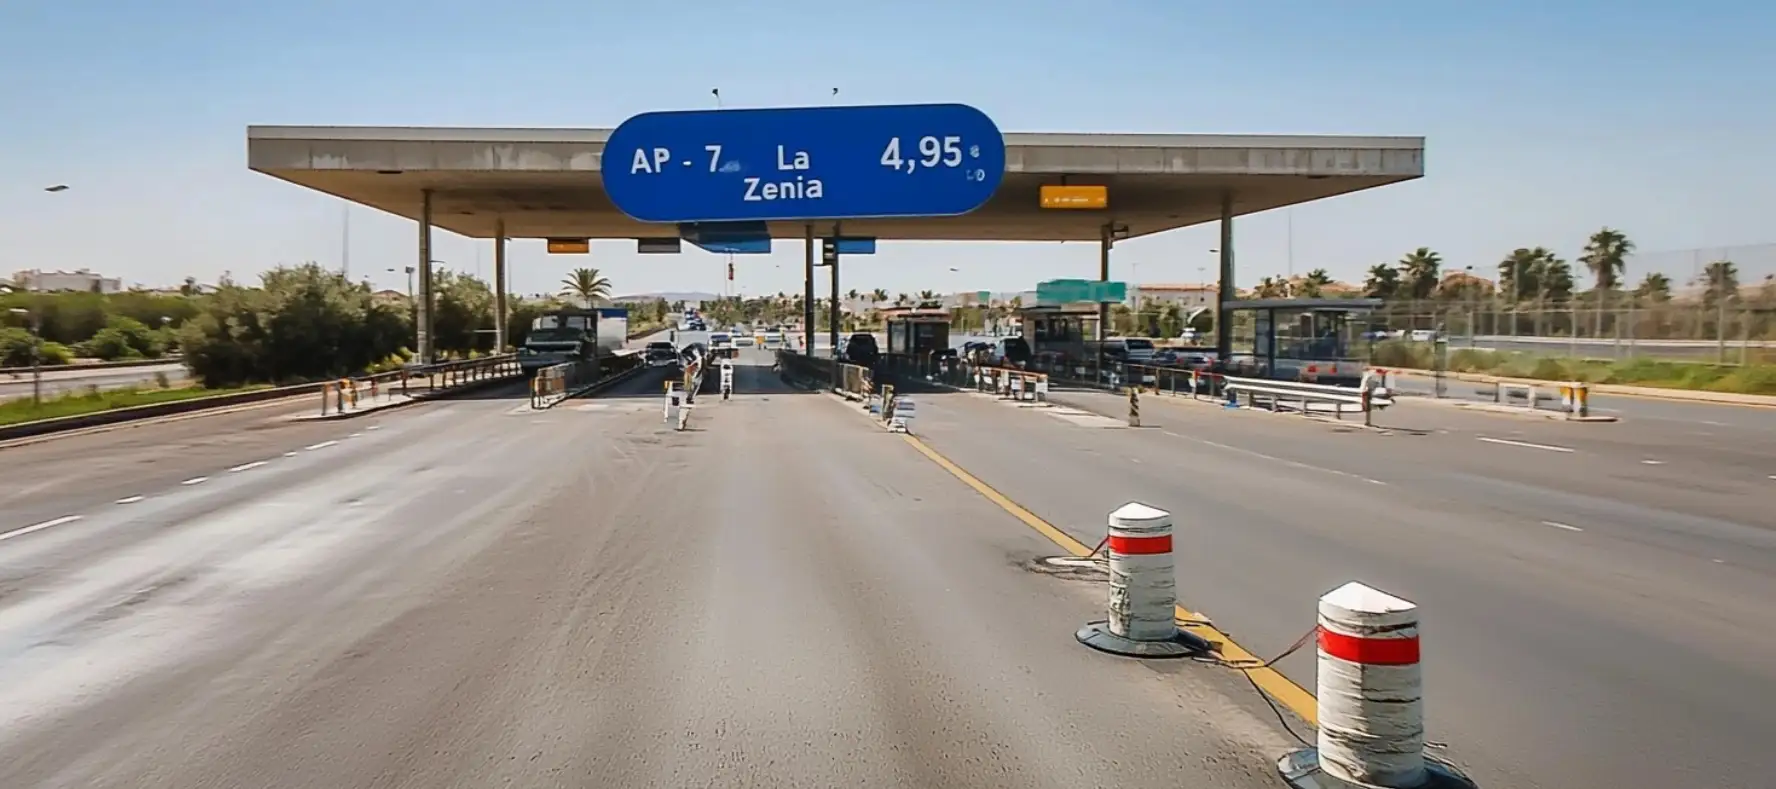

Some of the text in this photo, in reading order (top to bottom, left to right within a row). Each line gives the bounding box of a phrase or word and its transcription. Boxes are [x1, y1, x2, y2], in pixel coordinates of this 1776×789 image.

[630, 147, 671, 174] AP
[704, 145, 722, 173] 7
[777, 145, 810, 171] La
[880, 136, 963, 174] 4,95
[743, 175, 823, 202] Zenia
